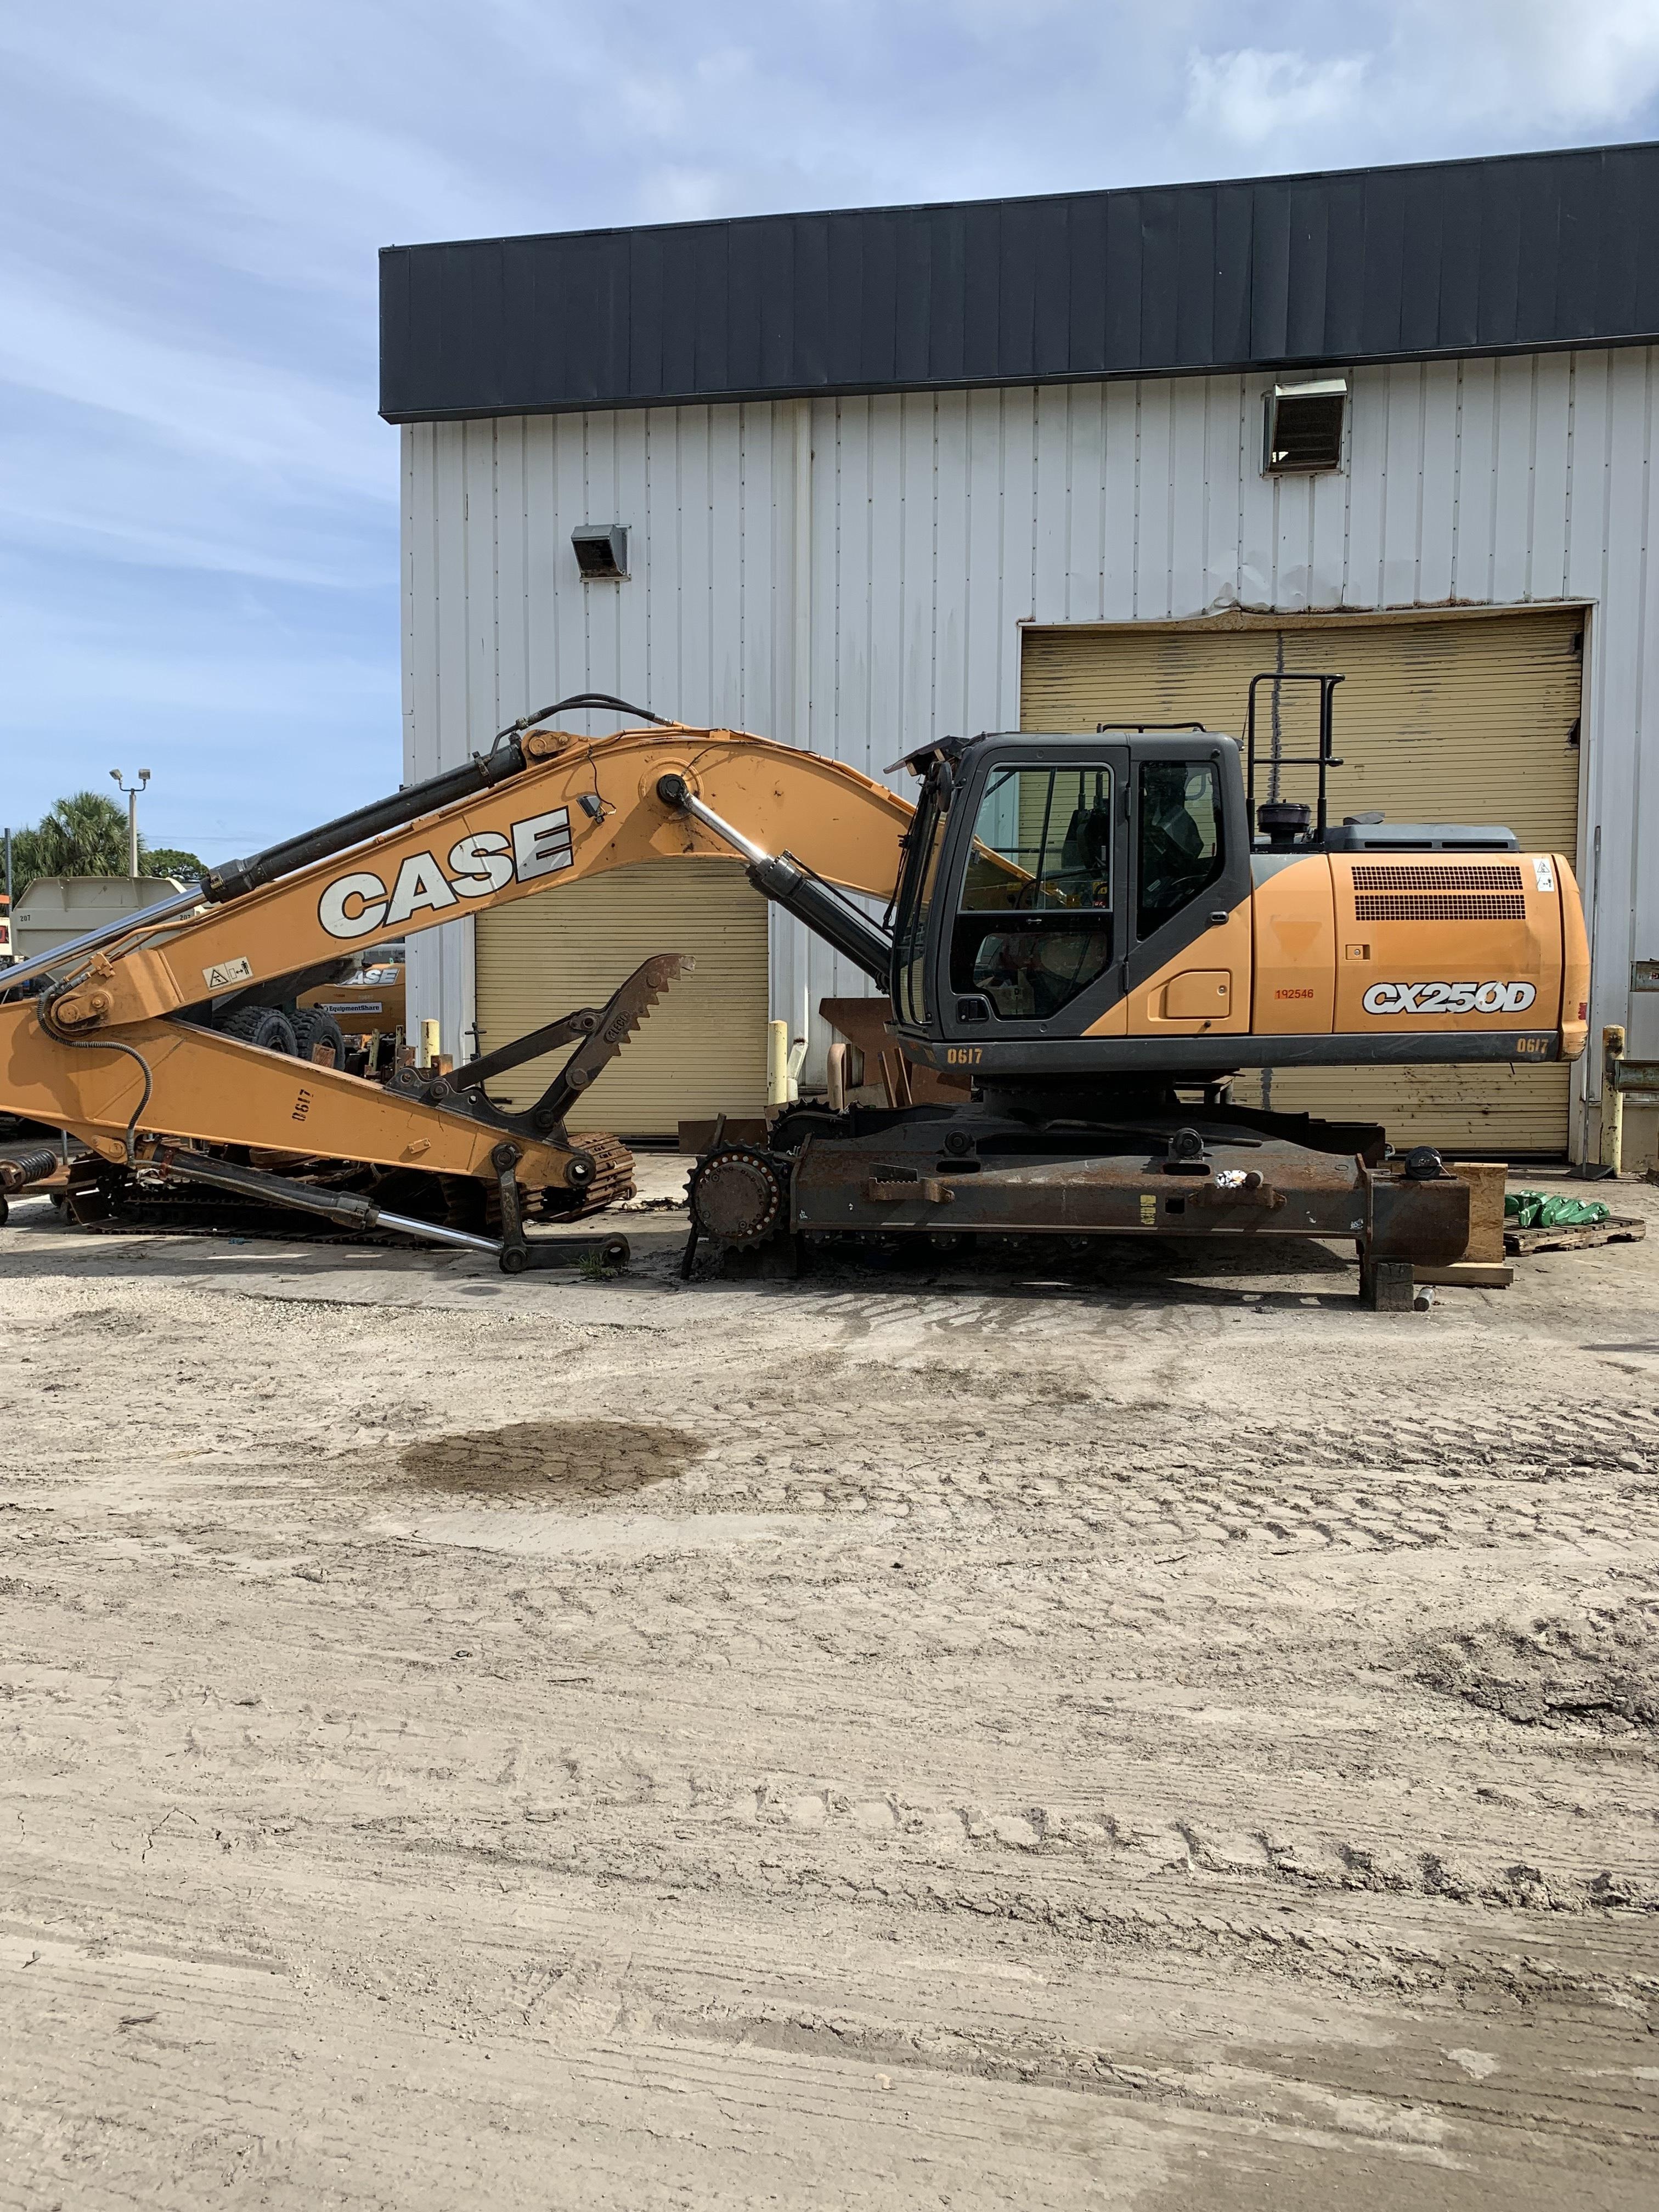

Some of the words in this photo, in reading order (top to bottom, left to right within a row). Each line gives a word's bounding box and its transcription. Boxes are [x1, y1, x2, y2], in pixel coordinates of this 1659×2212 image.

[317, 805, 574, 940] CASE
[339, 969, 399, 985] ASE
[1276, 989, 1314, 999] 192546
[1363, 981, 1536, 1014] CX250D
[1516, 1038, 1549, 1053] 0617
[947, 1048, 983, 1064] 0617
[292, 1089, 313, 1121] 0617
